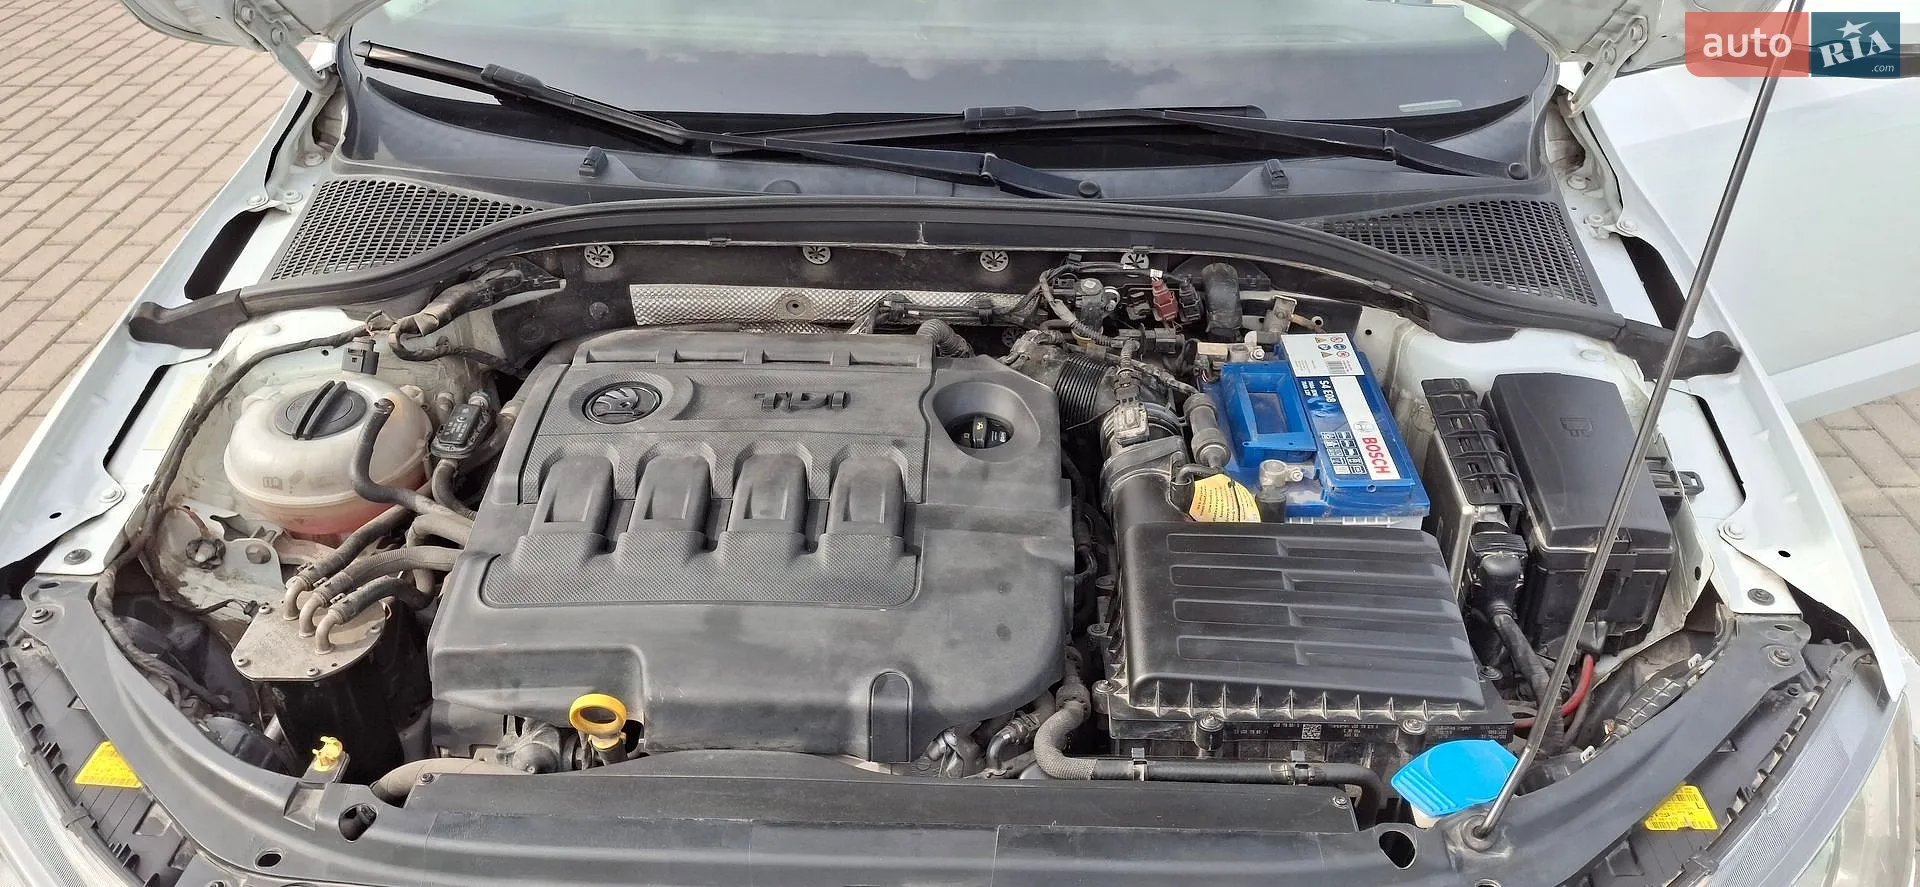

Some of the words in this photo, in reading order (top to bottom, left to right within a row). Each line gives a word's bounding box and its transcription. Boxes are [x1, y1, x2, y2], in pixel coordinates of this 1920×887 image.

[1319, 380, 1331, 389] S4
[753, 391, 851, 412] TDI
[1362, 437, 1390, 474] BOSCH
